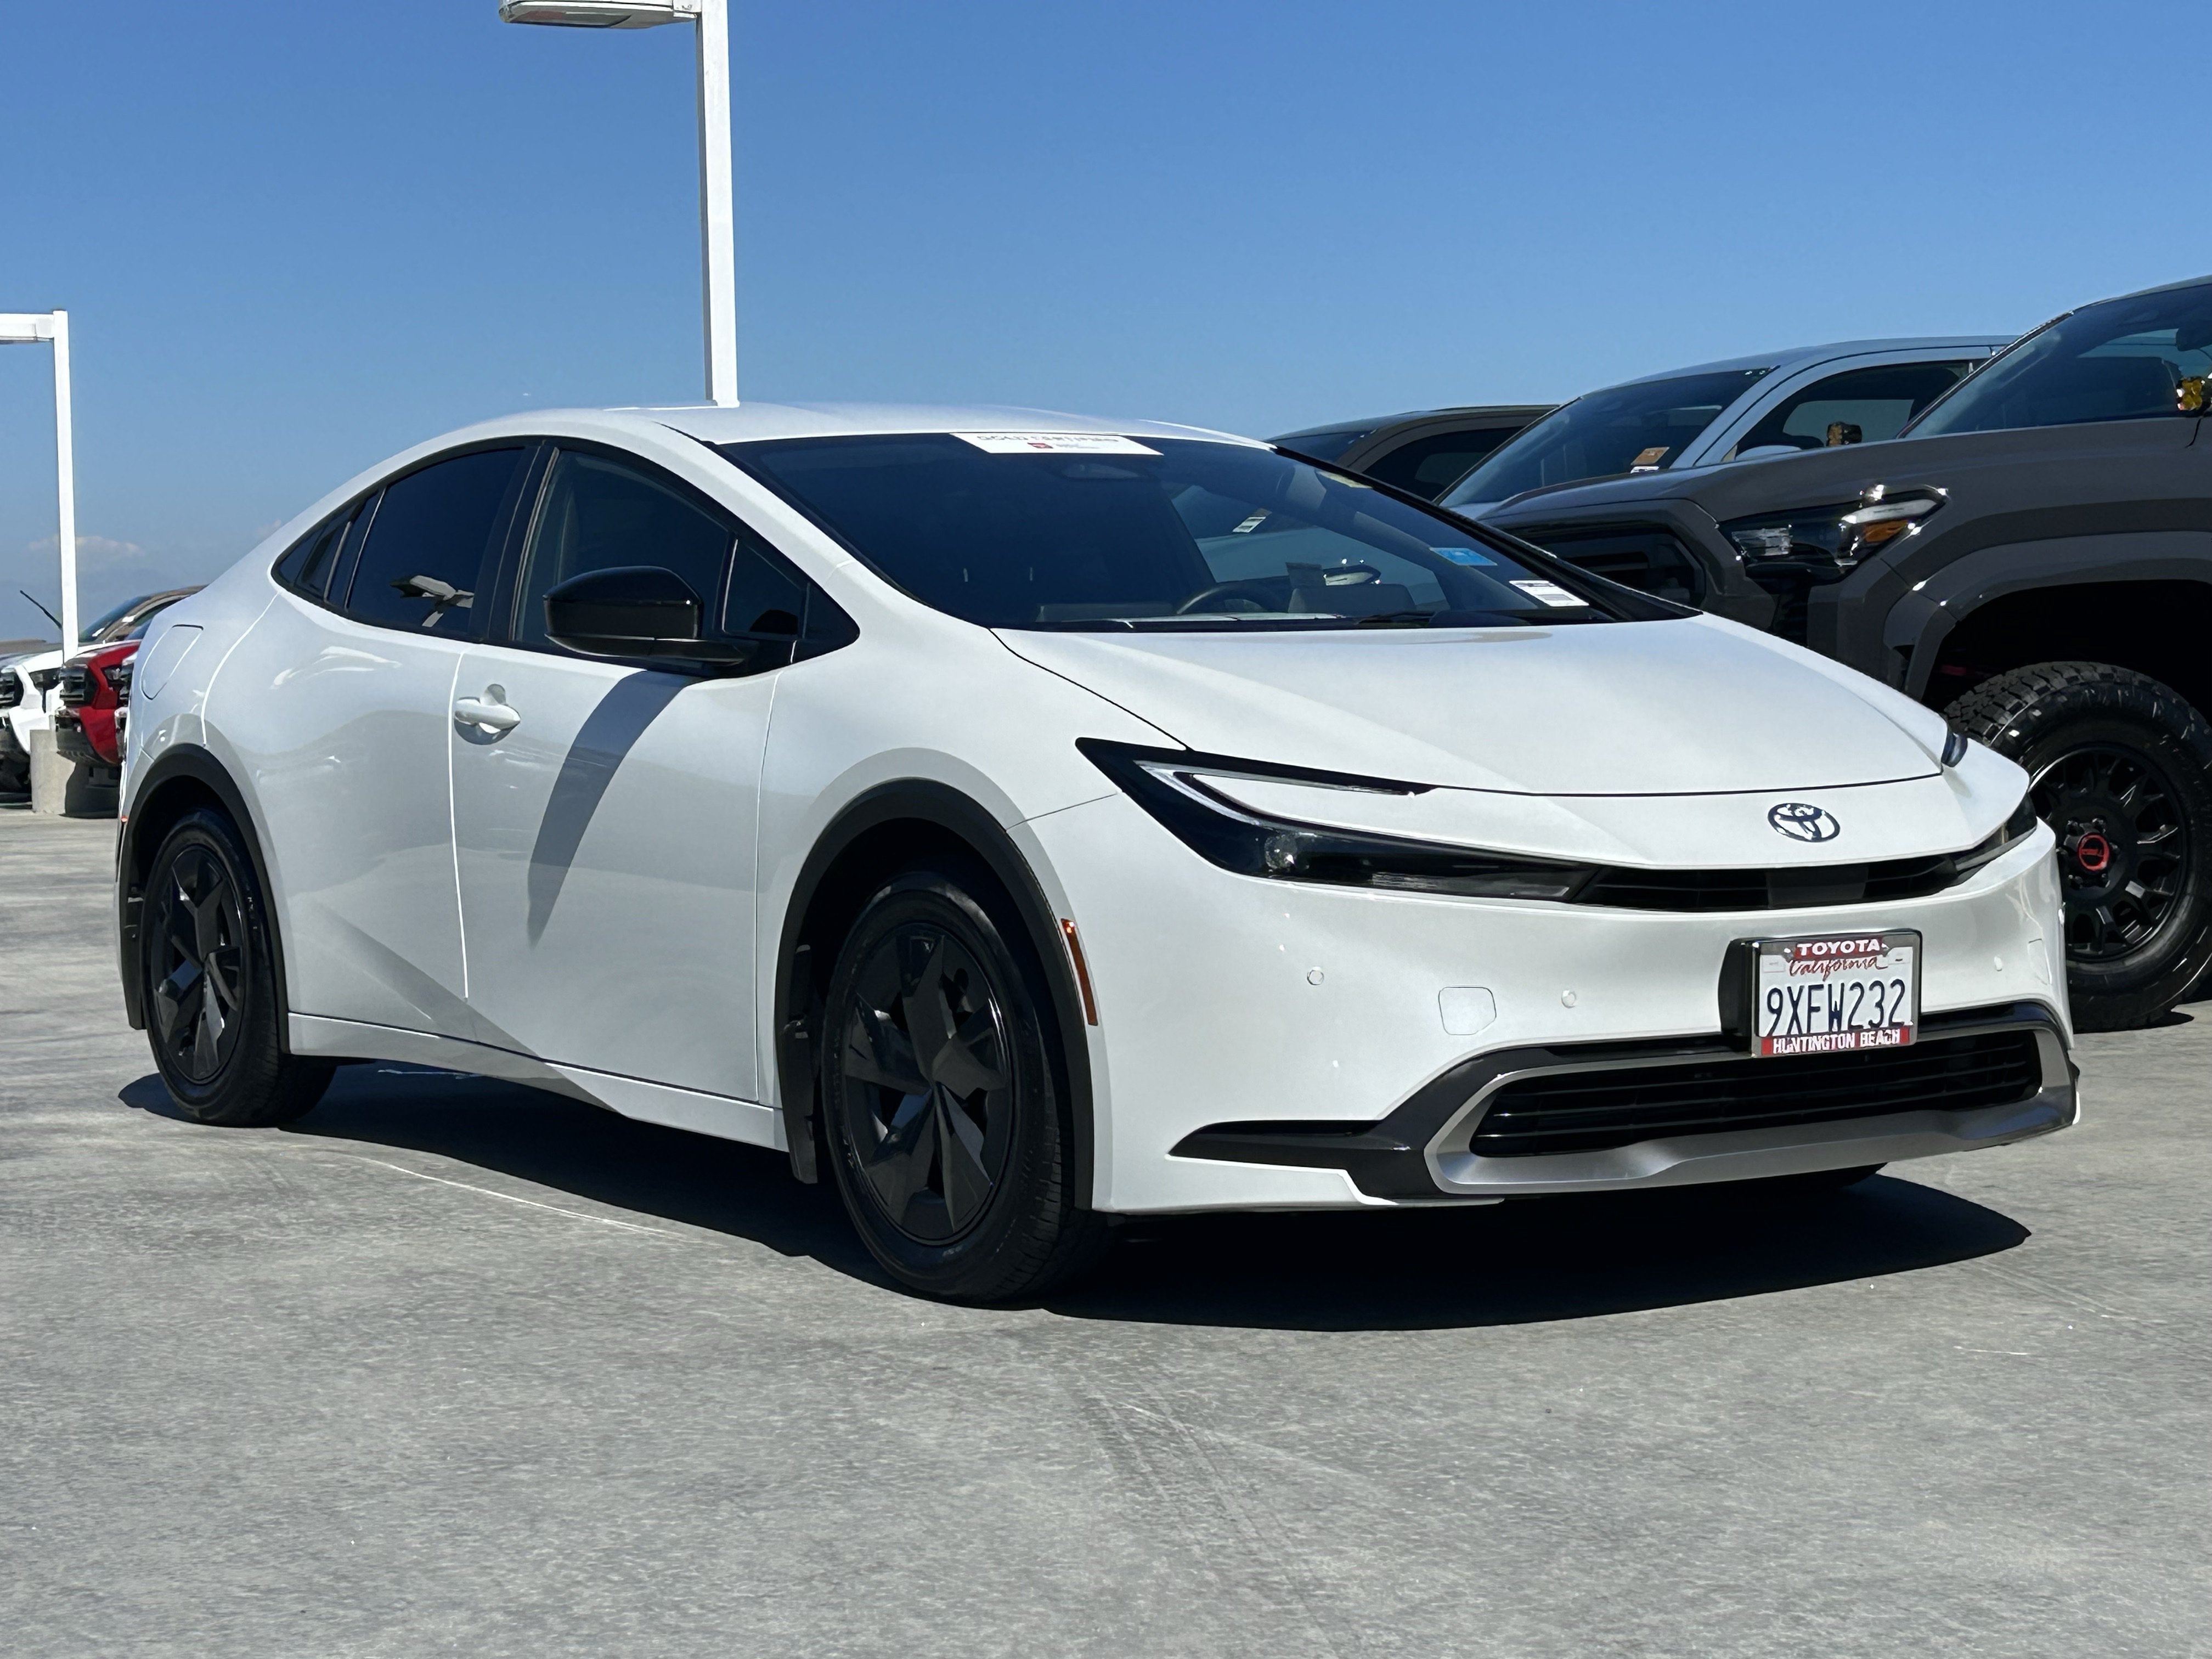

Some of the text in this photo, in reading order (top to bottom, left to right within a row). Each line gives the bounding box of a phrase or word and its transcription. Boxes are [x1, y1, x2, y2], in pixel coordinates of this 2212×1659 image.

[1797, 939, 1880, 956] TOYOTA
[1789, 956, 1888, 981] California
[1767, 979, 1905, 1036] 9XFW232
[1773, 1029, 1900, 1054] HUNTINGTON BEACH
